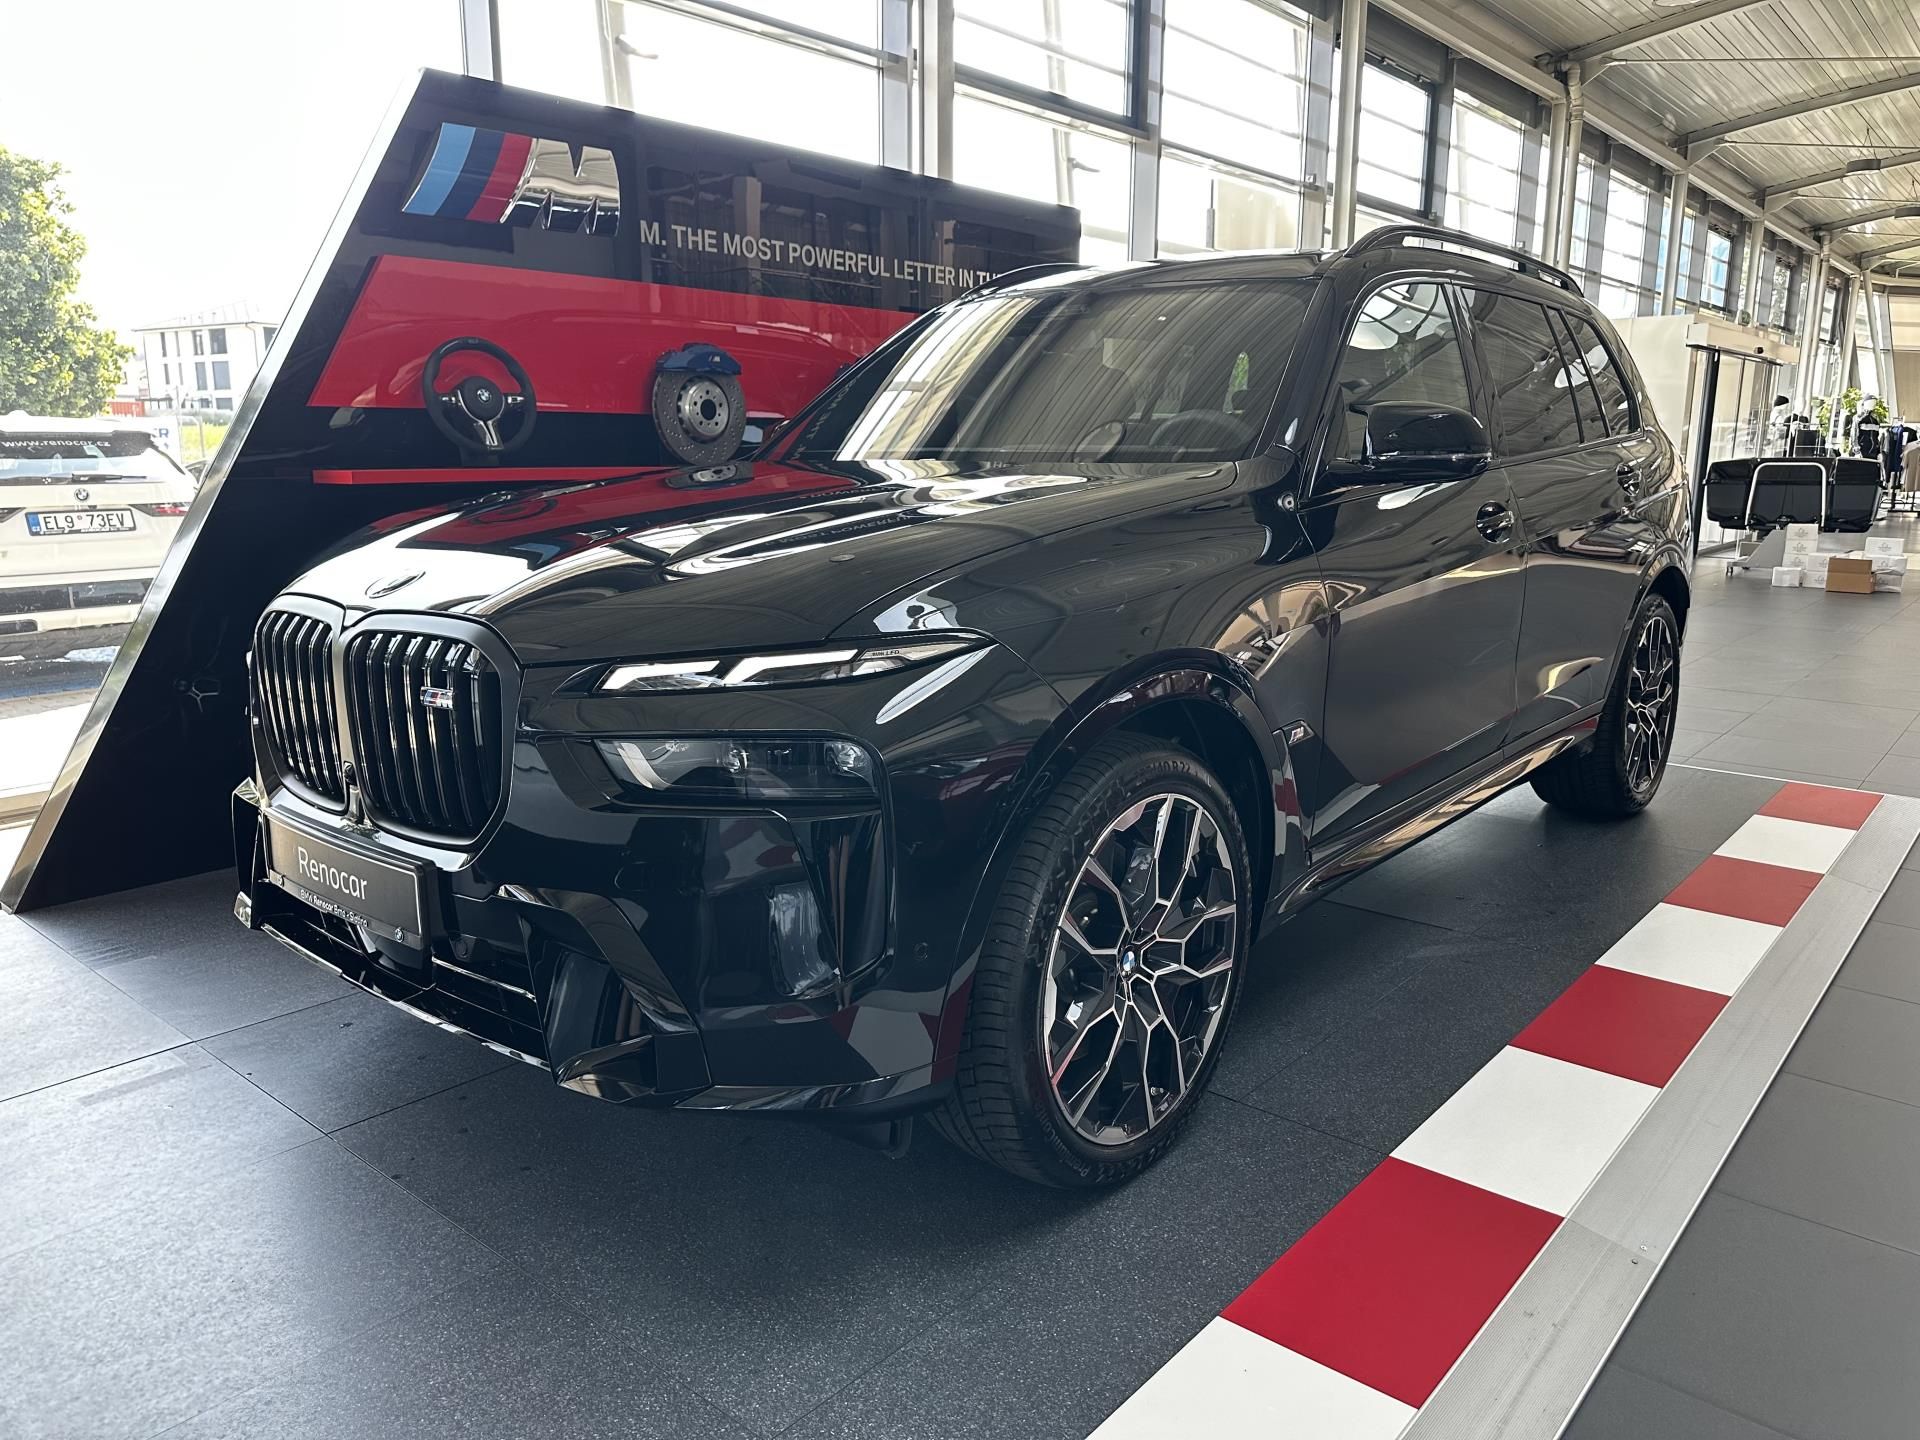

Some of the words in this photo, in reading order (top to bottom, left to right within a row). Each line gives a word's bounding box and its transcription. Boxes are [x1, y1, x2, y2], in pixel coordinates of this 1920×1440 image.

[640, 219, 667, 246] M.
[671, 224, 718, 253] THE
[723, 232, 784, 262] MOST
[788, 242, 890, 278] POWERFUL
[894, 258, 955, 287] LETTER
[959, 268, 974, 288] IN
[1, 440, 111, 448] www.renocar.cz
[43, 515, 75, 530] EL9
[86, 513, 125, 527] 73EV
[298, 846, 367, 899] Renocar
[313, 895, 334, 911] Renocar
